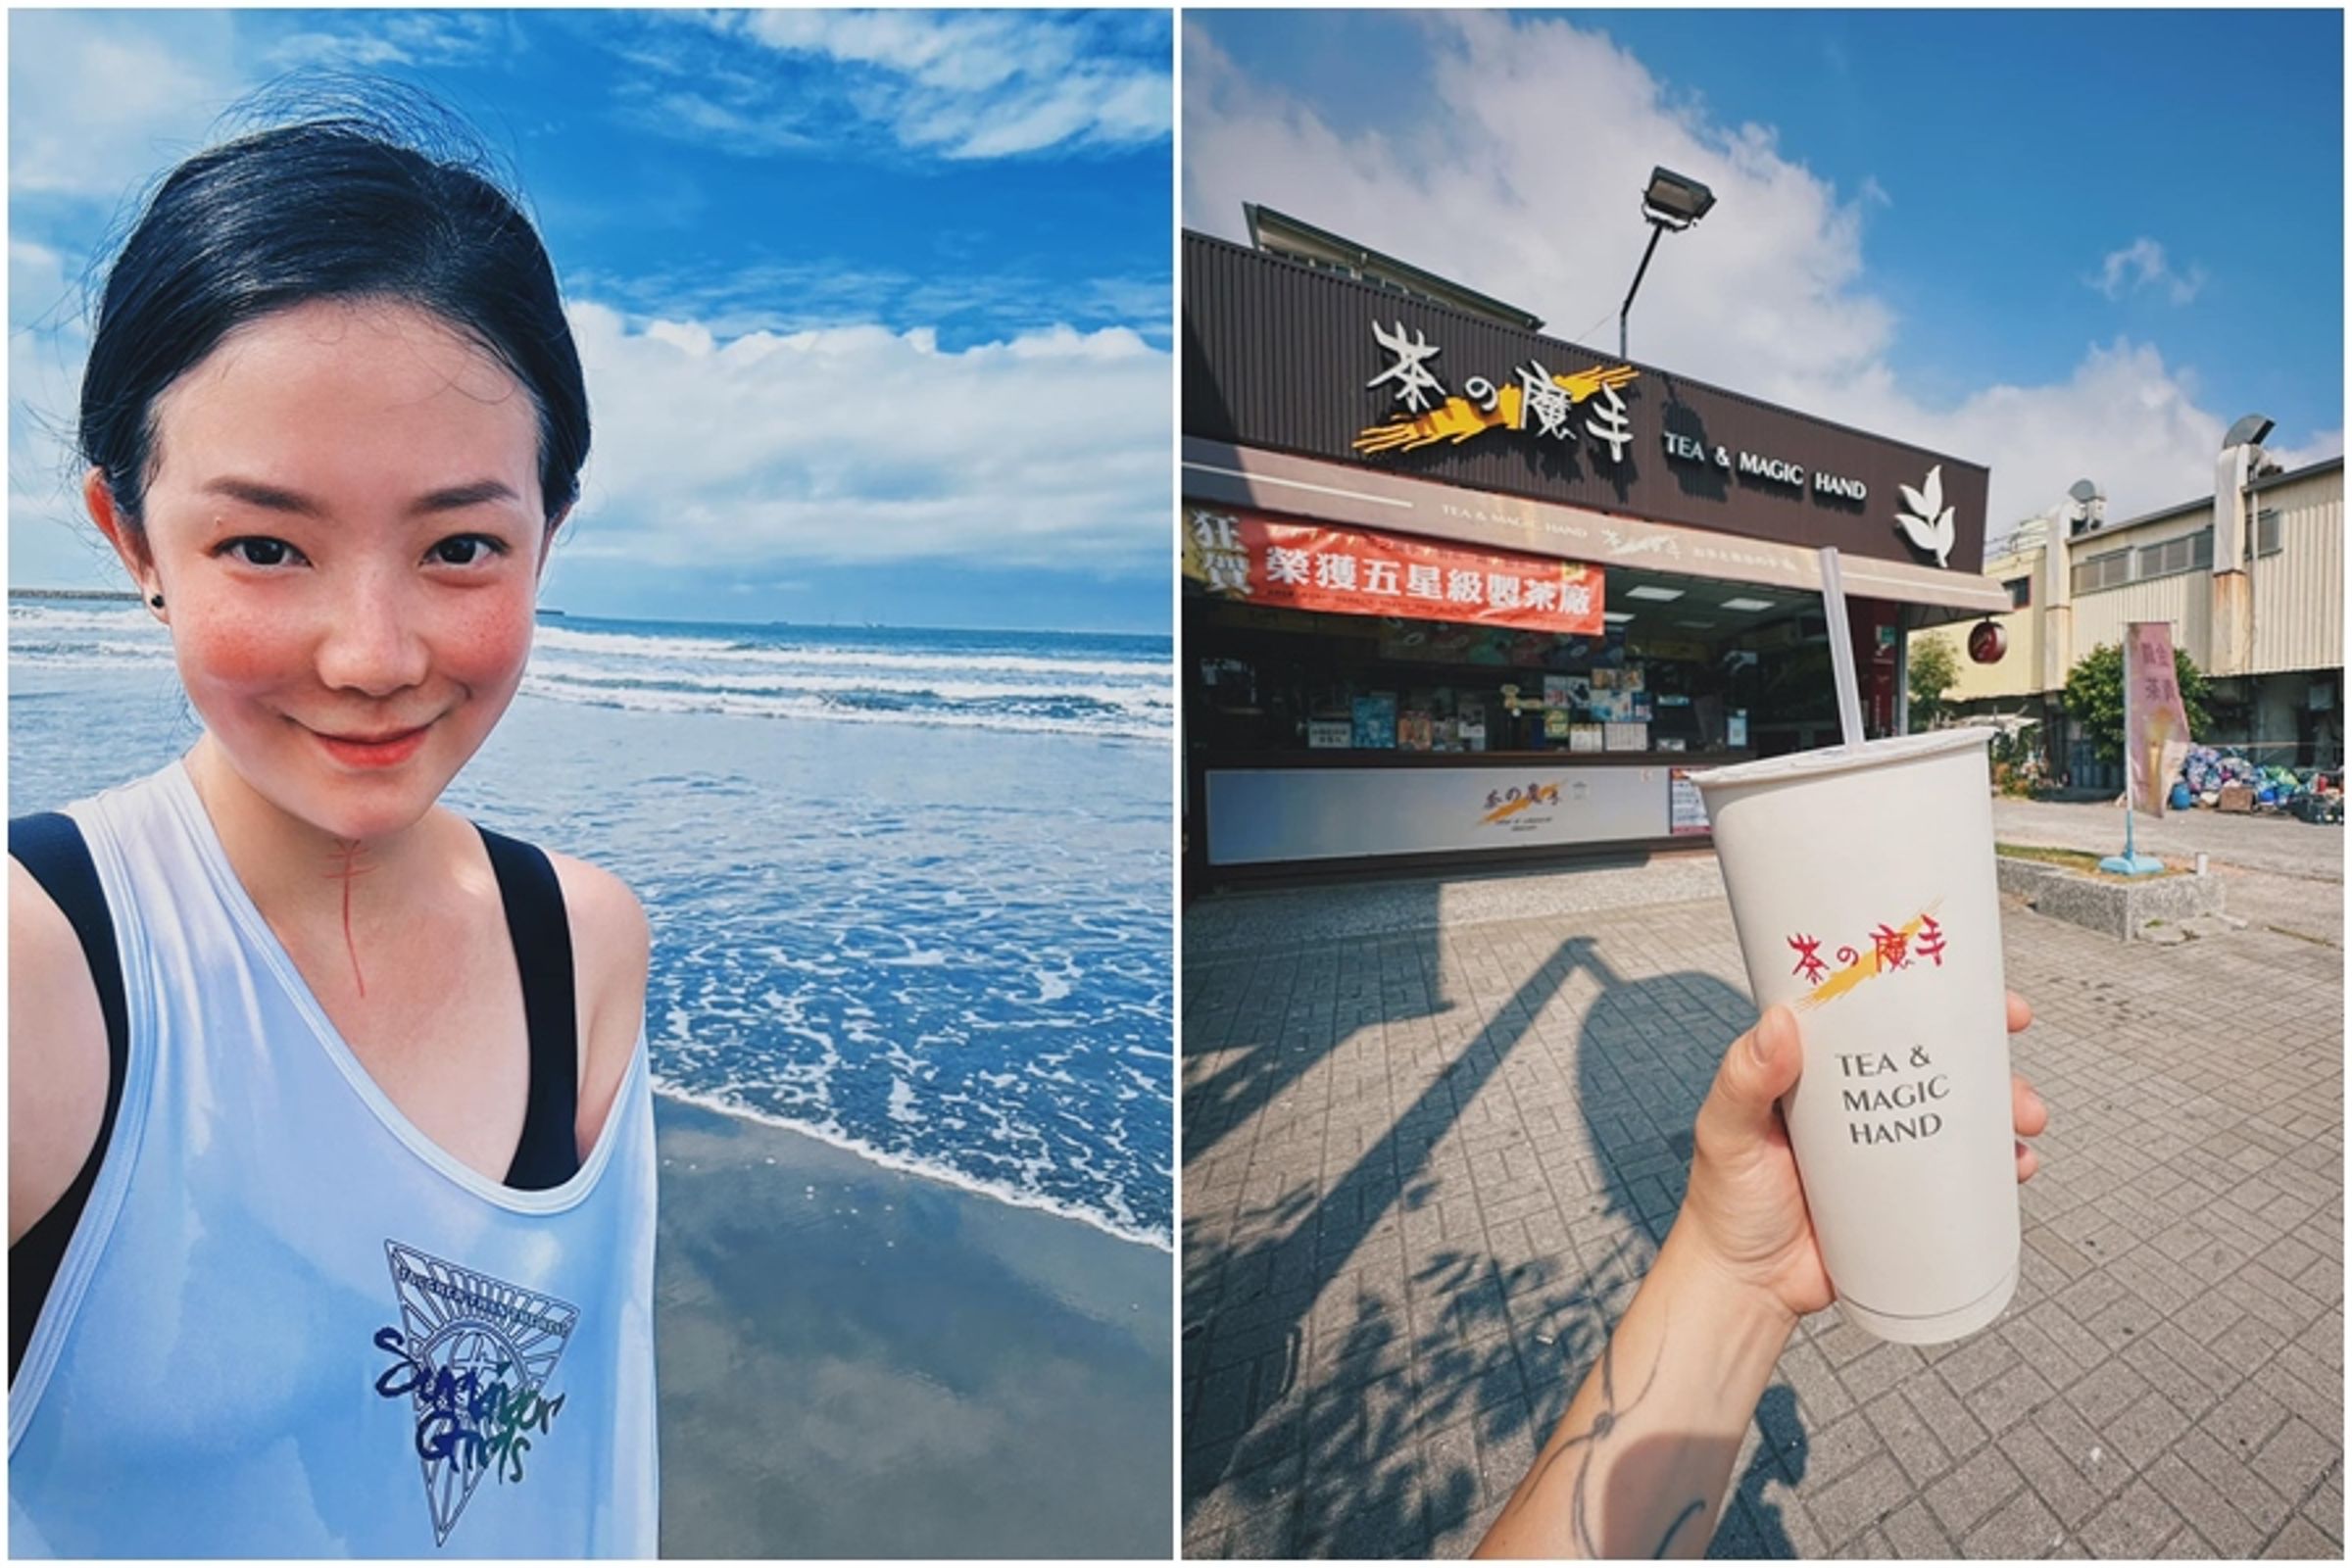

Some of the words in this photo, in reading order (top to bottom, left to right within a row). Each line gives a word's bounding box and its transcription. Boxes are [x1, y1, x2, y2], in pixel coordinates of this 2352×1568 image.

[1366, 318, 1634, 463] 茶の魔手
[1664, 431, 1705, 462] TEA
[1715, 446, 1731, 466] &
[1739, 452, 1804, 485] MAGIC
[1815, 472, 1867, 500] HAND
[1442, 504, 1471, 518] TEA
[1491, 512, 1533, 528] MAG
[1544, 521, 1589, 538] HAND
[1194, 510, 1255, 595] 狂賀
[1787, 913, 1946, 985] 茶の魔手
[1836, 1053, 1898, 1078] TEA
[1909, 1044, 1932, 1067] &
[1842, 1074, 1950, 1111] MAGIC
[1849, 1112, 1942, 1145] HAND
